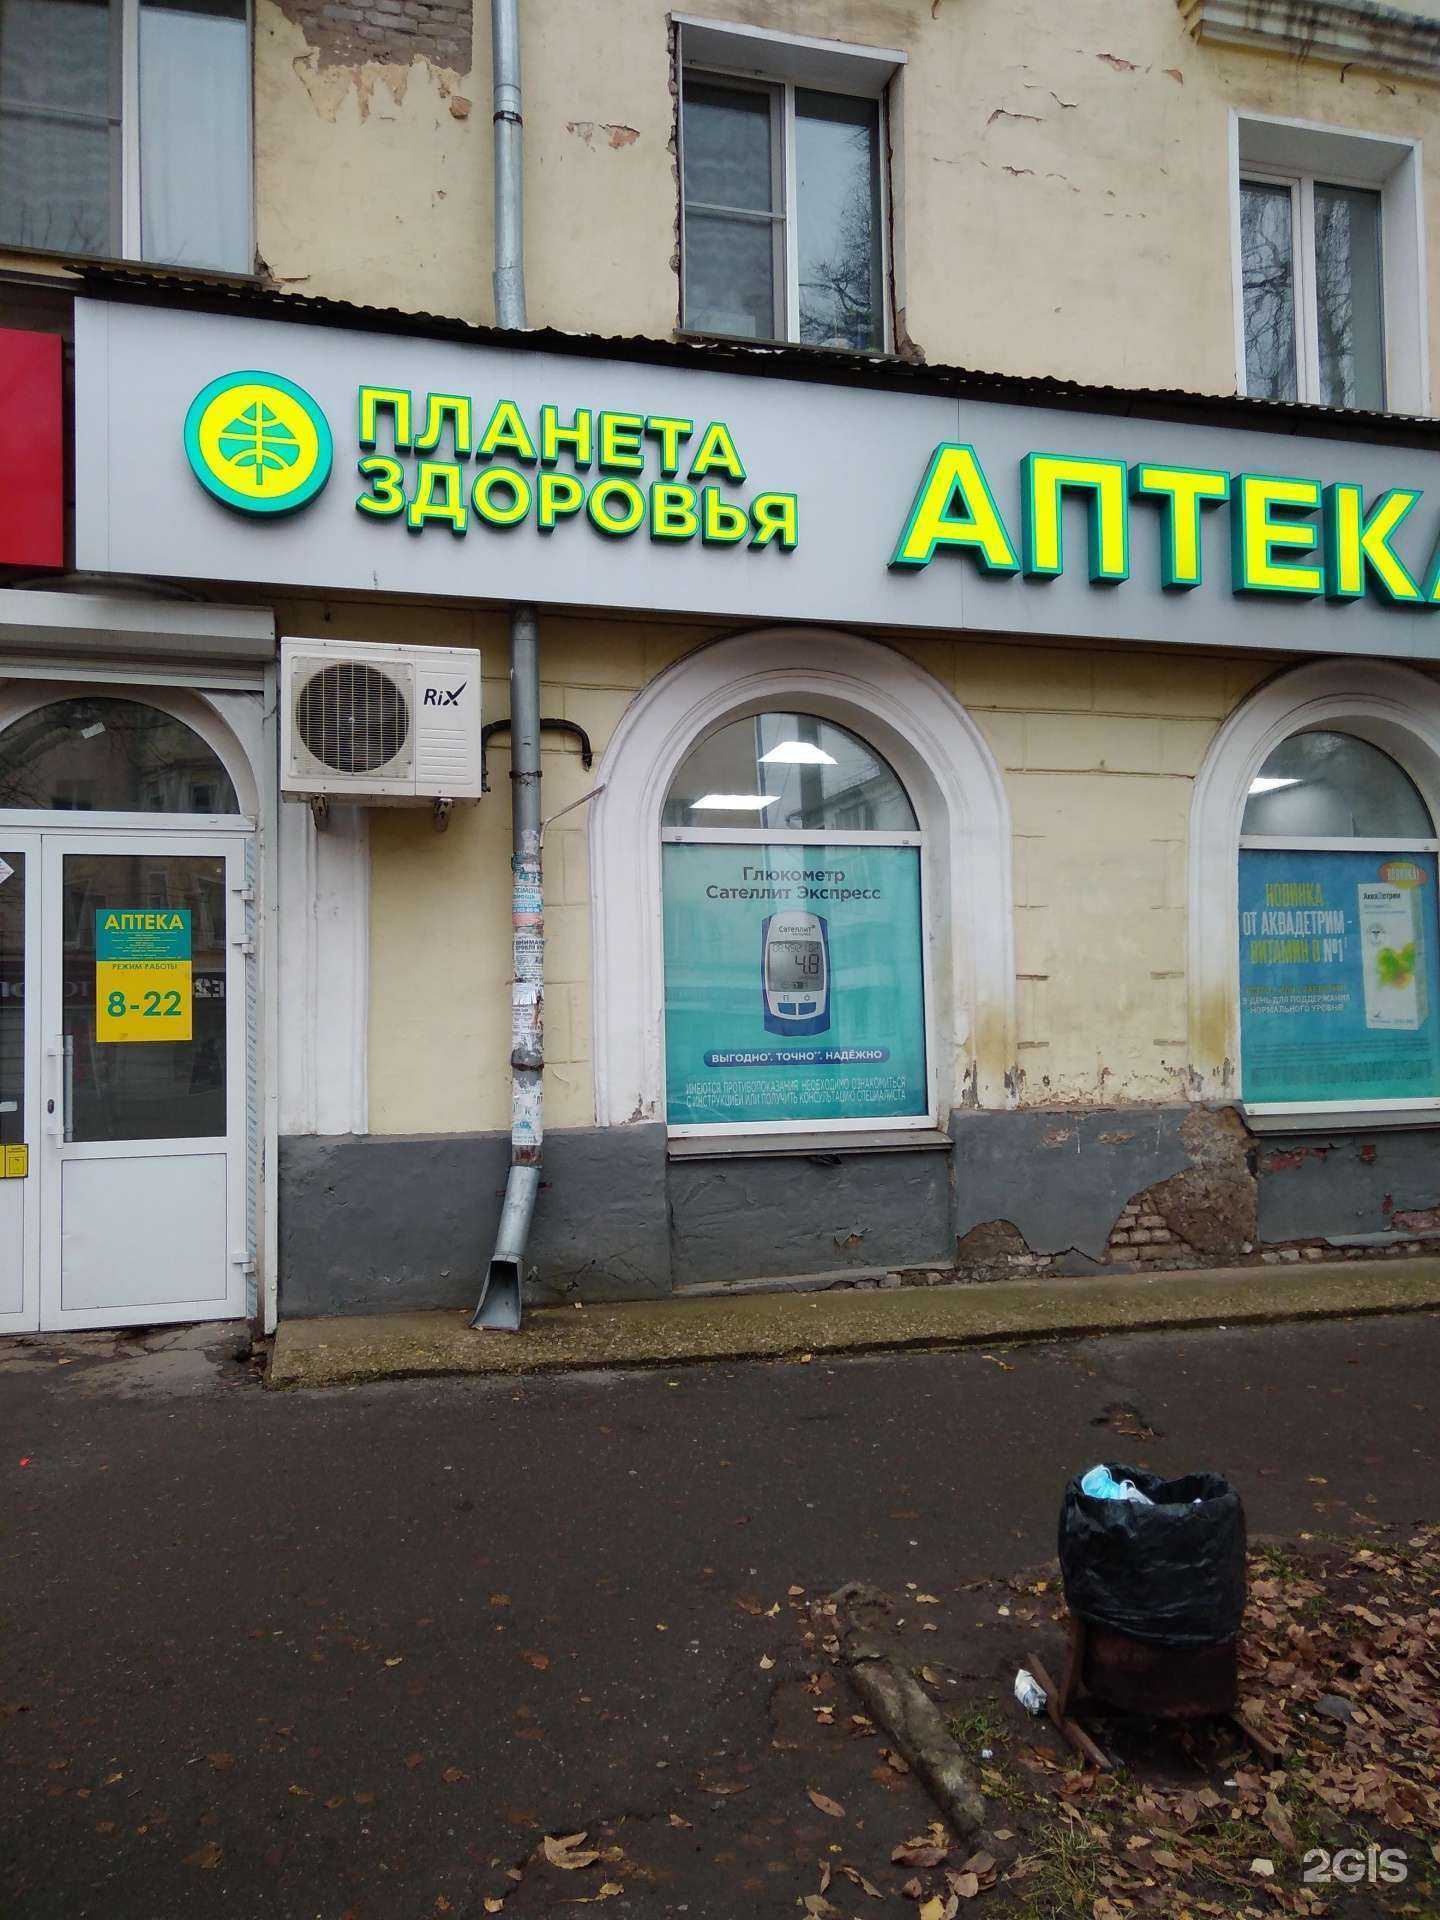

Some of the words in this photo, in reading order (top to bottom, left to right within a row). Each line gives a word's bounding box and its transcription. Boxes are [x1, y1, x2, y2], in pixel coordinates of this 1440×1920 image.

[358, 385, 747, 484] ПЛАНЕТА
[355, 455, 798, 552] ЗДОРОВЬЯ
[887, 441, 1440, 605] АПТЕК
[743, 866, 845, 884] Глюкометр
[706, 884, 791, 900] Сателлит
[796, 884, 881, 902] Экспресс
[104, 914, 185, 930] АПТЕКА
[1243, 911, 1257, 936] ОТ
[1261, 910, 1345, 938] АКВАДЕТРИМ
[825, 1049, 883, 1060] НАДЁЖНО
